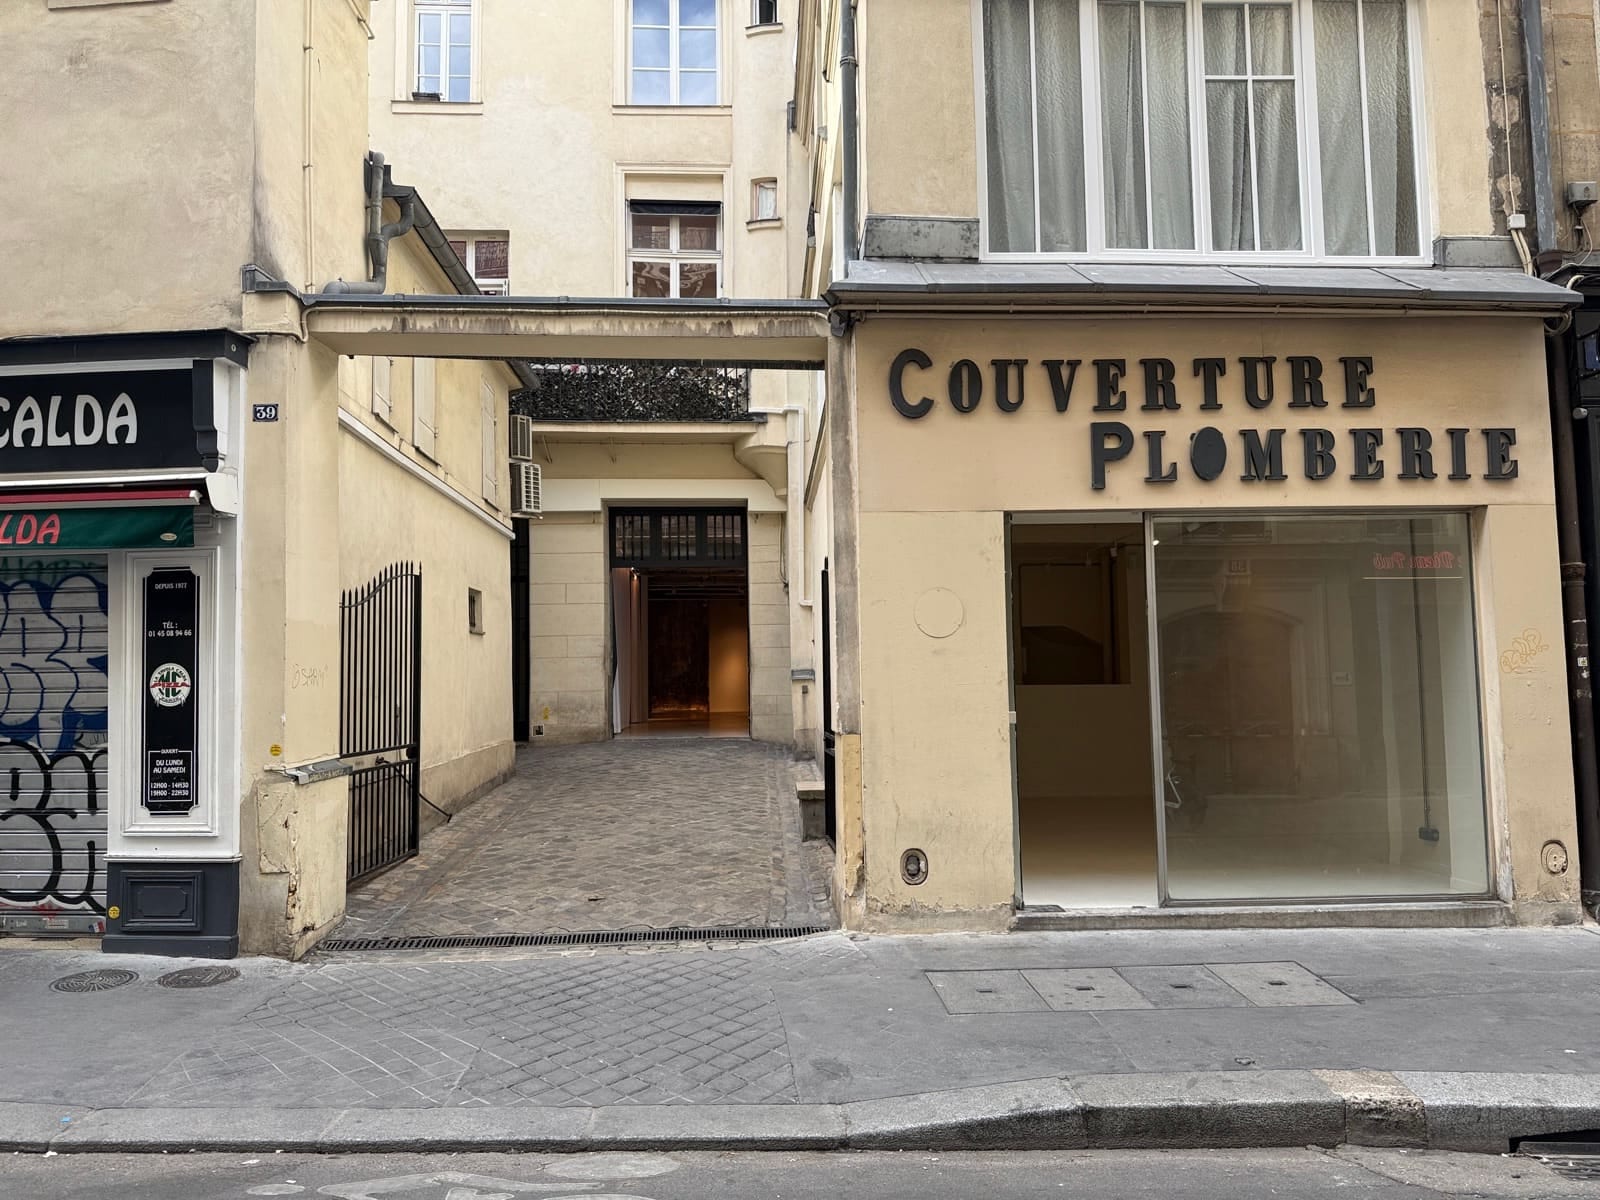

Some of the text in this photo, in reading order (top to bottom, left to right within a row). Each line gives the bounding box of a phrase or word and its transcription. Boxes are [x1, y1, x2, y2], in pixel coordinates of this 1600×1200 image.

[889, 348, 1376, 419] COUVERTURE
[256, 406, 276, 419] 39
[1090, 420, 1519, 489] PLOMBERIE
[0, 513, 60, 544] LDA
[163, 766, 186, 774] SAMEDI
